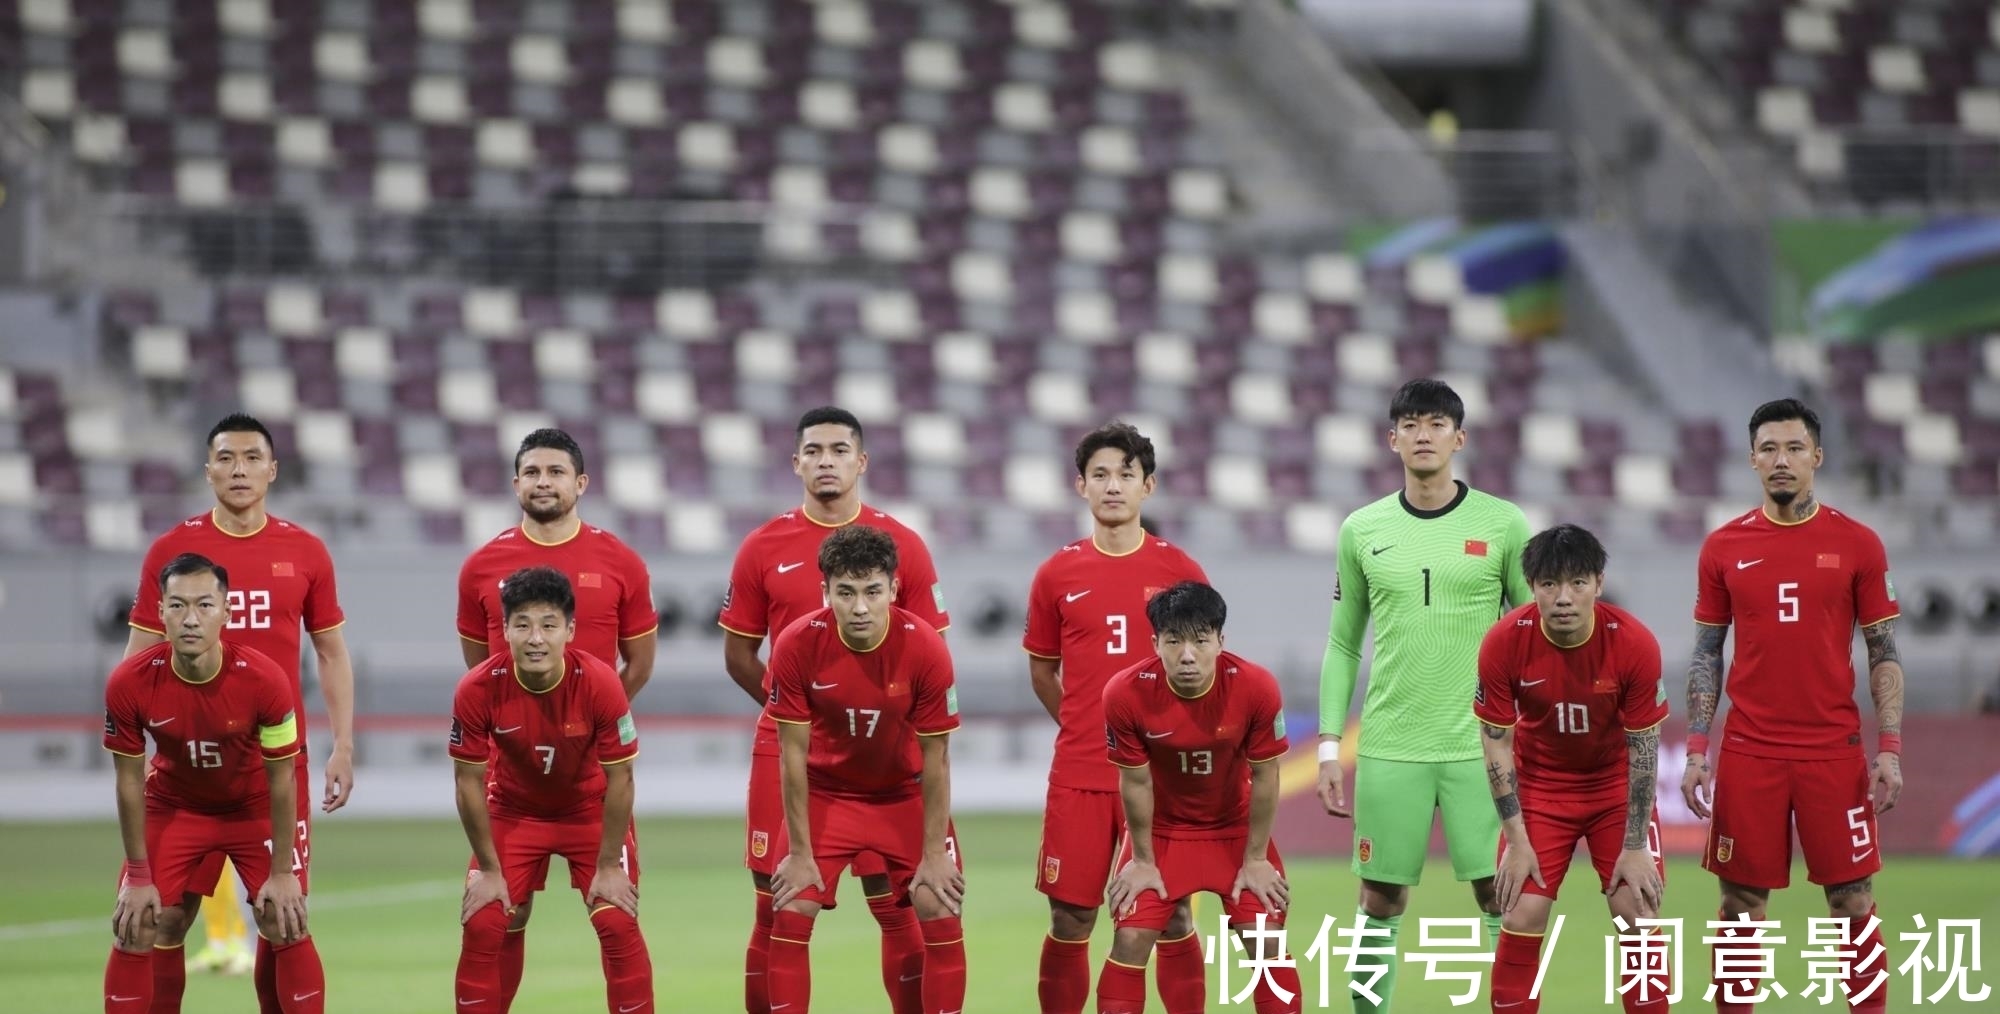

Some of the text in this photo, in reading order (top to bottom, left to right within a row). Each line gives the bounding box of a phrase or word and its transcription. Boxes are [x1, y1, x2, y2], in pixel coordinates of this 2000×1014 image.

[1421, 568, 1430, 606] 1
[1778, 583, 1799, 622] 5
[226, 590, 270, 628] 22
[1106, 615, 1127, 654] 3
[846, 708, 881, 738] 17
[1554, 702, 1589, 733] 10
[187, 740, 222, 768] 15
[535, 745, 555, 774] 7
[1178, 751, 1212, 775] 13
[1847, 806, 1870, 847] 5
